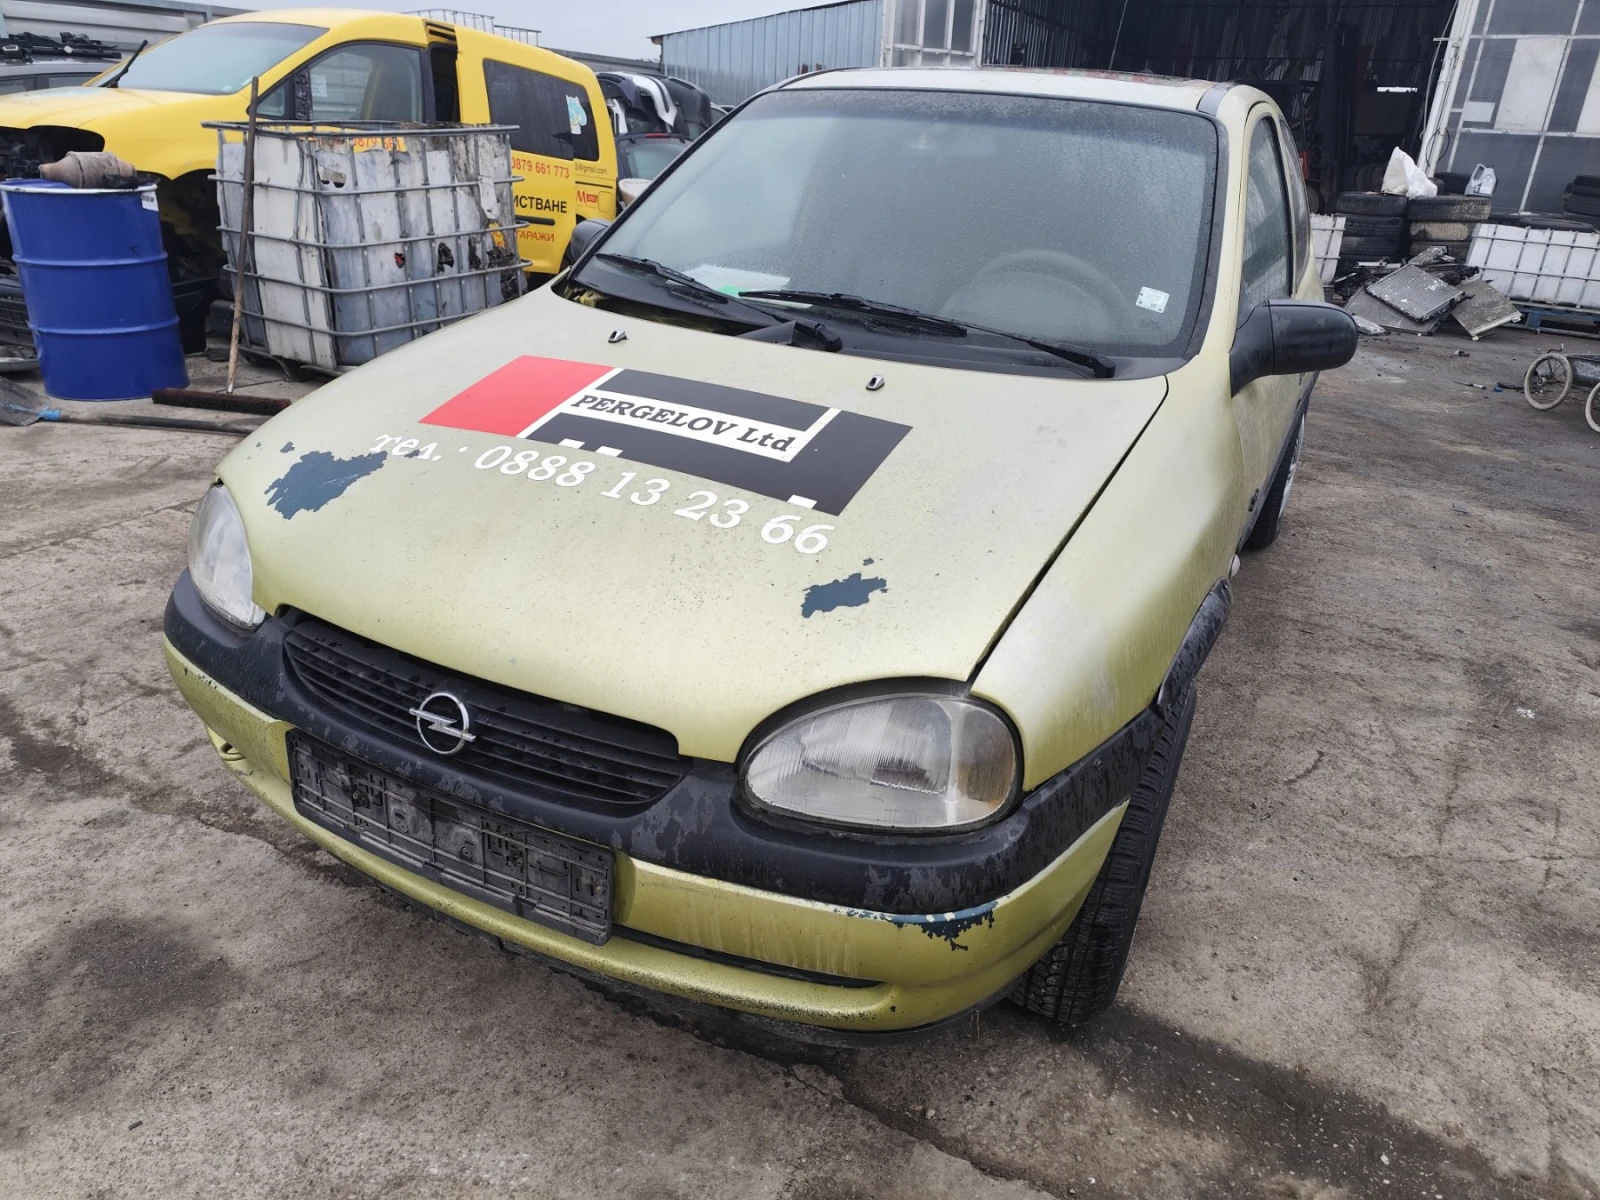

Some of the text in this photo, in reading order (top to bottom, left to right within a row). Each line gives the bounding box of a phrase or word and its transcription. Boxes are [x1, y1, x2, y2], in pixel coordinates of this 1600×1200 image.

[535, 162, 551, 175] 661
[554, 165, 570, 179] 773
[570, 394, 796, 452] PERGELOV Ltd
[474, 445, 596, 487] 0888
[600, 471, 671, 506] 13
[673, 490, 750, 529] 23
[760, 514, 836, 555] 66
